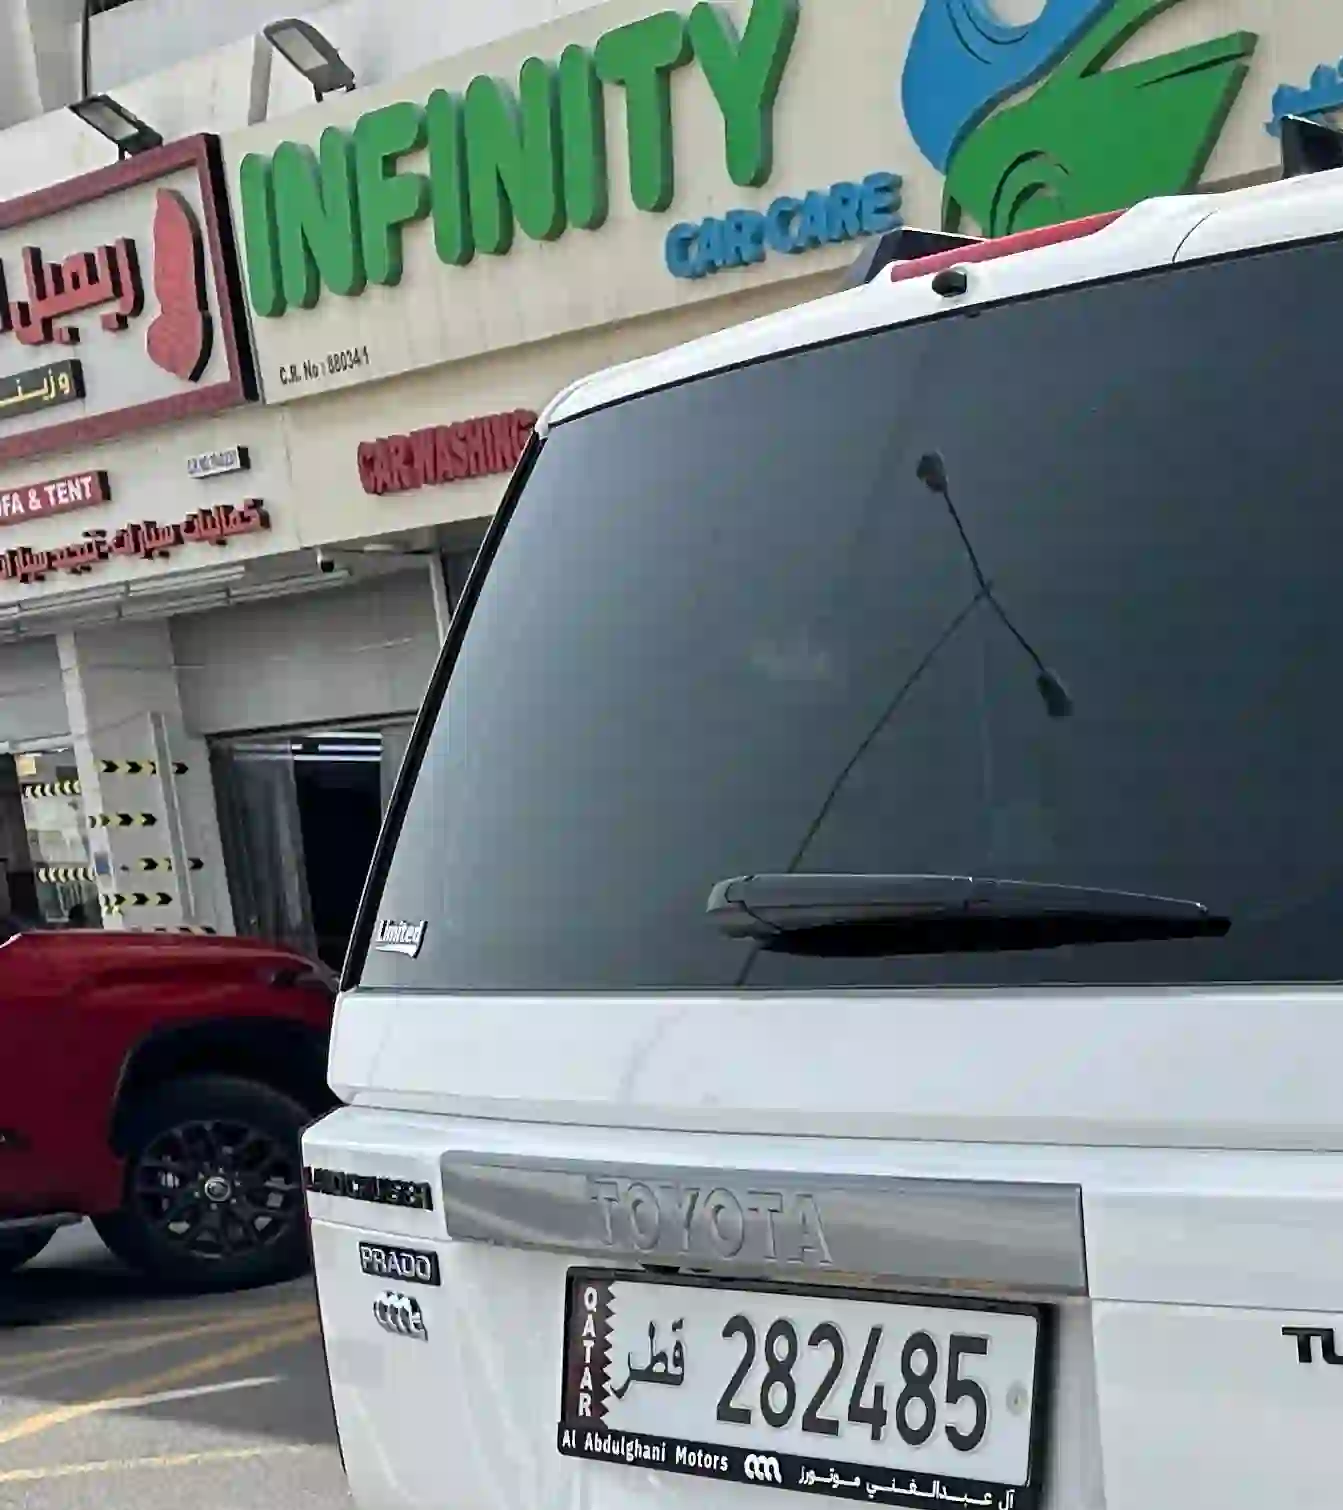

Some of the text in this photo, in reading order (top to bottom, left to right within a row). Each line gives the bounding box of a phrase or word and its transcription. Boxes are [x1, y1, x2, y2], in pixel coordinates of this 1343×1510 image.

[239, 0, 799, 318] INFINITY
[665, 171, 904, 280] CAR CARE
[28, 488, 42, 511] &
[44, 475, 92, 507] TENT
[357, 408, 538, 494] CAR WASHING
[360, 1246, 431, 1281] PRADO
[588, 1175, 833, 1266] TOYOTA
[576, 1286, 598, 1418] QATAR
[608, 1317, 686, 1400] قطر
[716, 1314, 989, 1453] 282485
[561, 1429, 577, 1449] Al
[584, 1432, 667, 1463] Abdulghani
[675, 1445, 729, 1472] Motors
